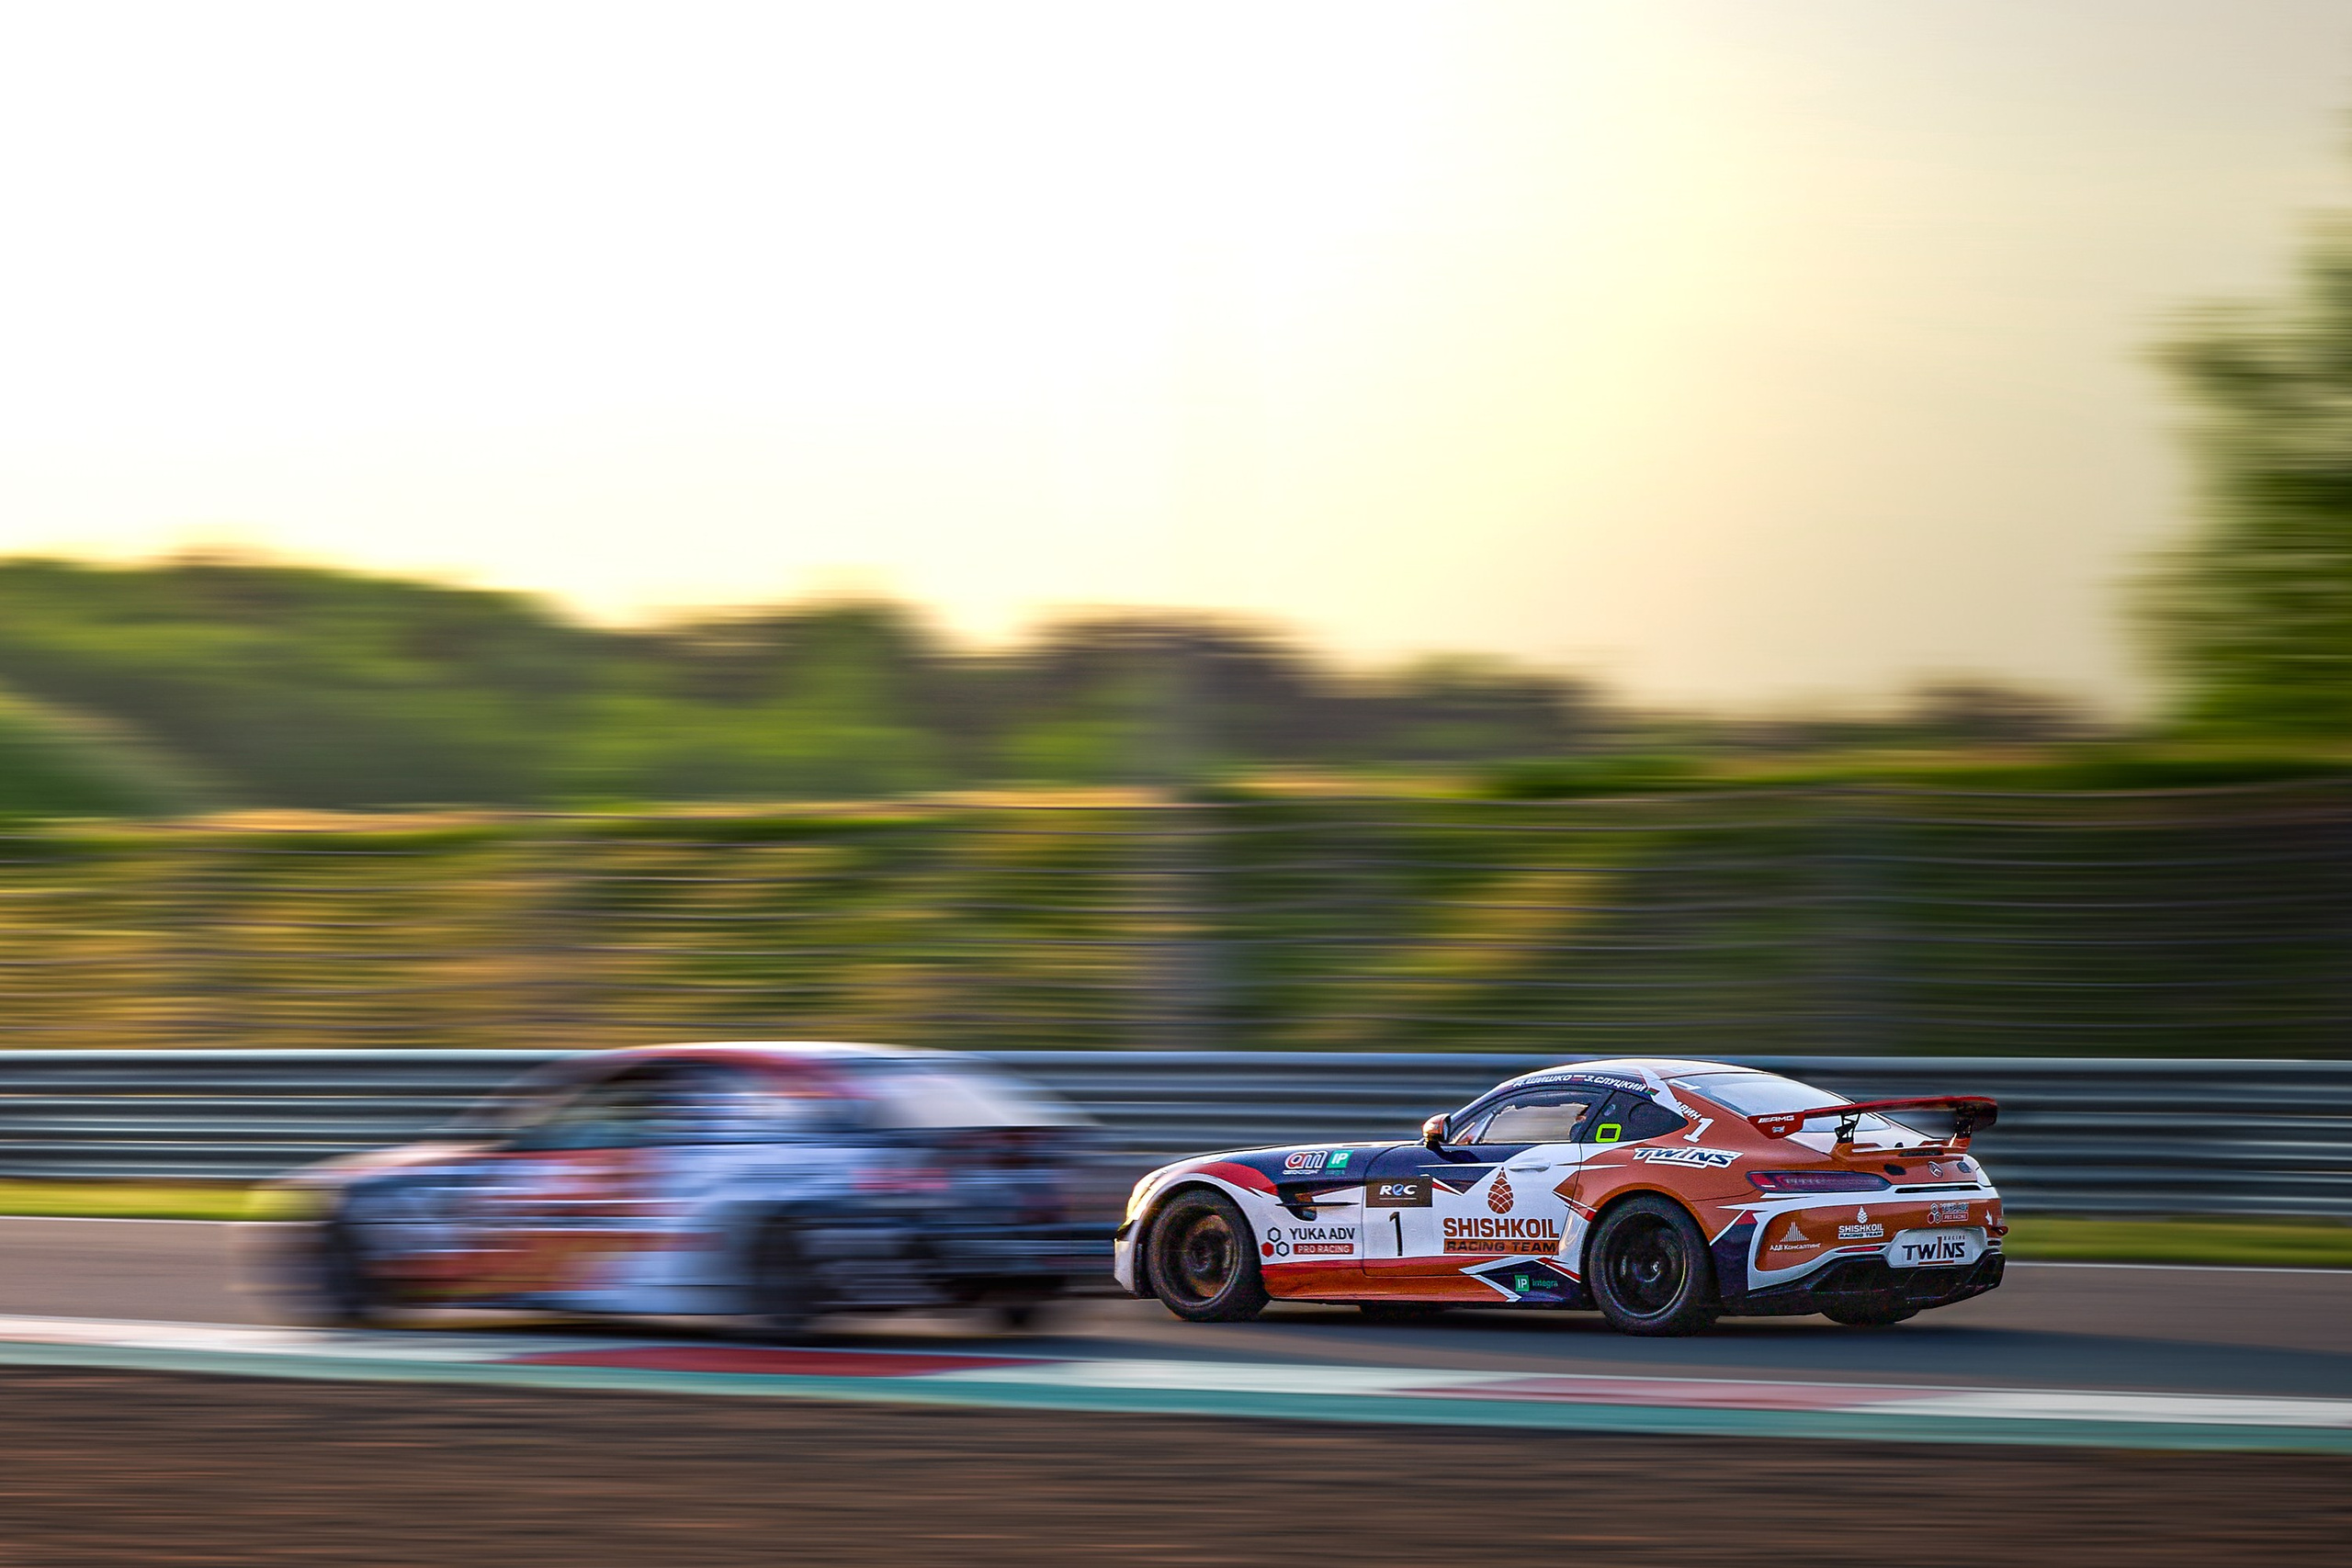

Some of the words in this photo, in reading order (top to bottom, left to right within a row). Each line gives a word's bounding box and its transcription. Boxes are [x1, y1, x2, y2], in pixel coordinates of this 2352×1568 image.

[1682, 1117, 1714, 1143] 1
[1331, 1153, 1349, 1164] IP
[1289, 1228, 1326, 1240] YUKA
[1329, 1228, 1355, 1239] ADV
[1389, 1212, 1403, 1256] 1
[1442, 1218, 1559, 1238] SHISHKOIL
[1838, 1224, 1883, 1234] SHISHKOIL
[1317, 1245, 1350, 1253] RACING
[1447, 1241, 1505, 1252] RACING
[1510, 1242, 1556, 1253] TEAM
[1518, 1279, 1528, 1289] IP
